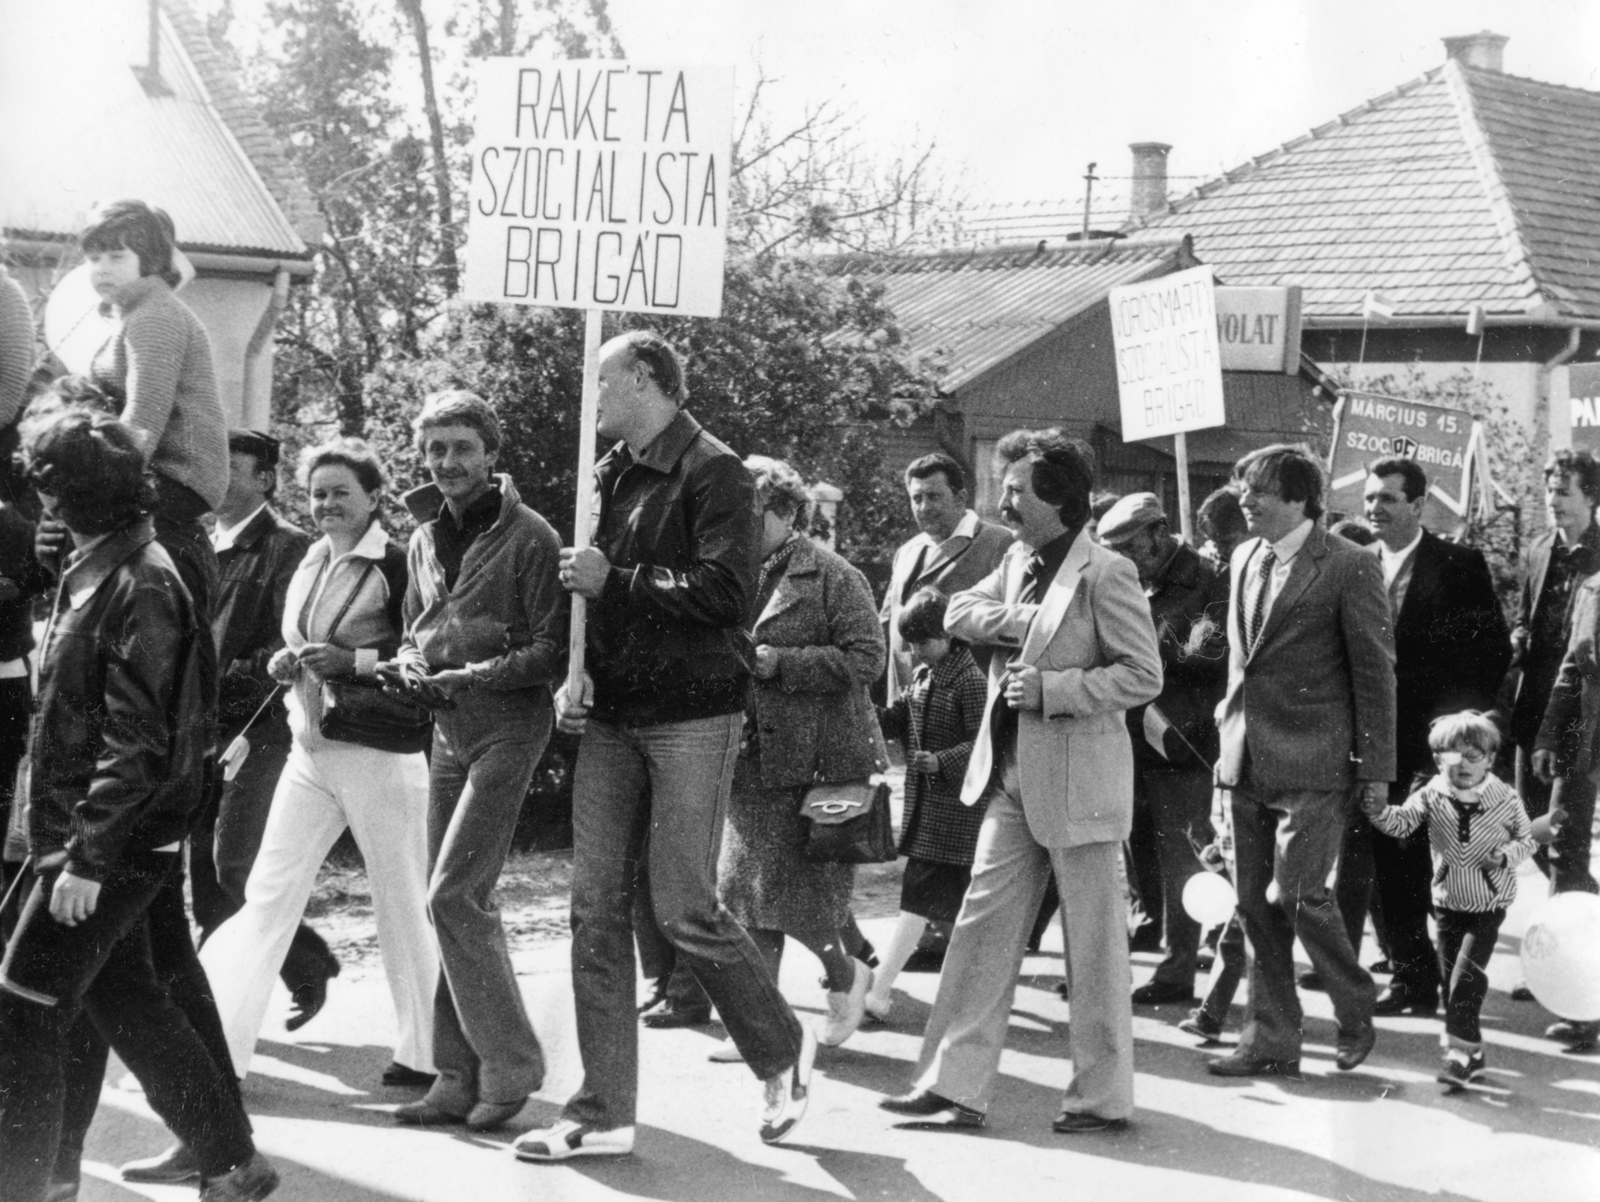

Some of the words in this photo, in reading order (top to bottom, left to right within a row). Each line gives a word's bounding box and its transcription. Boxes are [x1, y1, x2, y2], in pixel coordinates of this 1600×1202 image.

[516, 65, 690, 143] RAKÉTA
[478, 146, 717, 227] SZOCIALISTA
[503, 225, 683, 308] BRIGÁD
[1118, 328, 1214, 385] SZOCIALISTA
[1216, 313, 1279, 345] YOLAT
[1350, 398, 1428, 428] MÁRCIUS
[1437, 414, 1463, 434] 15.
[1416, 445, 1464, 469] BRIGÁ
